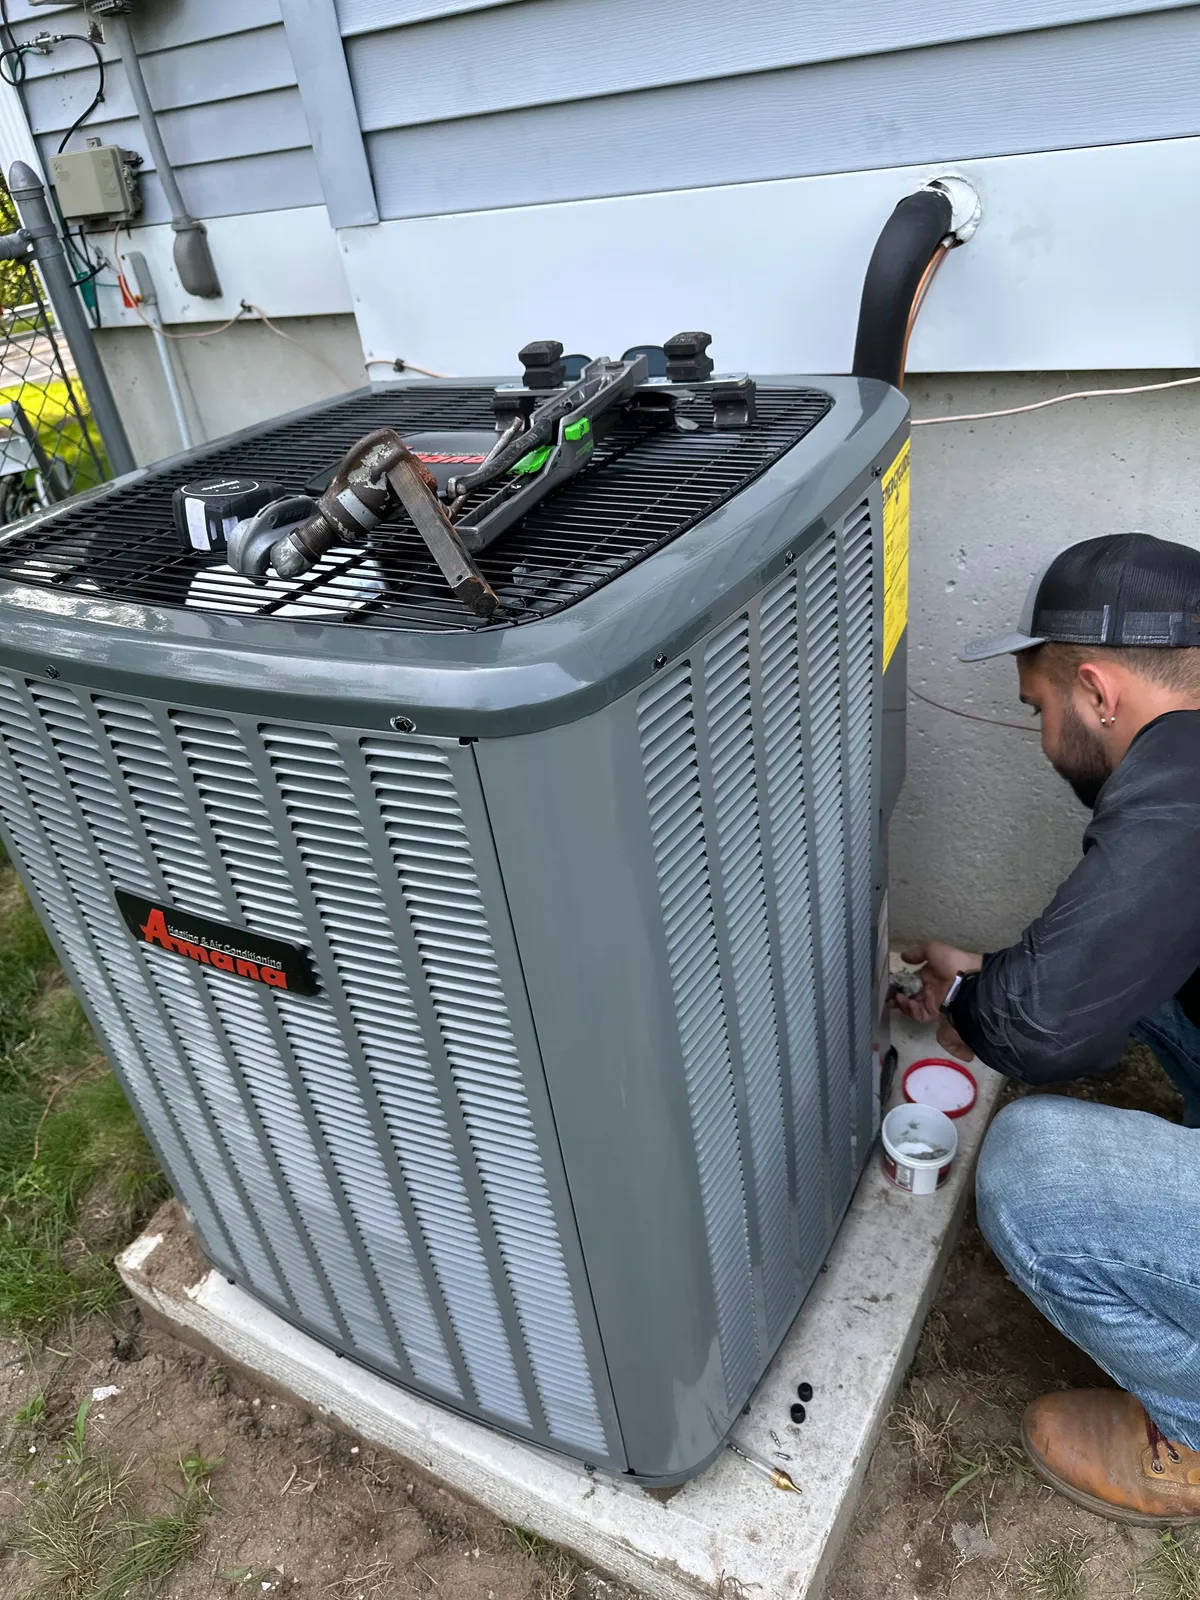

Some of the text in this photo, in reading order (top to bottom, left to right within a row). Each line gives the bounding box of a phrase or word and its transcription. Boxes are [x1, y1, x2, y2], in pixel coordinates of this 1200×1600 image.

[140, 908, 288, 989] Amana
[167, 925, 282, 970] Heating & Air Conditioning
